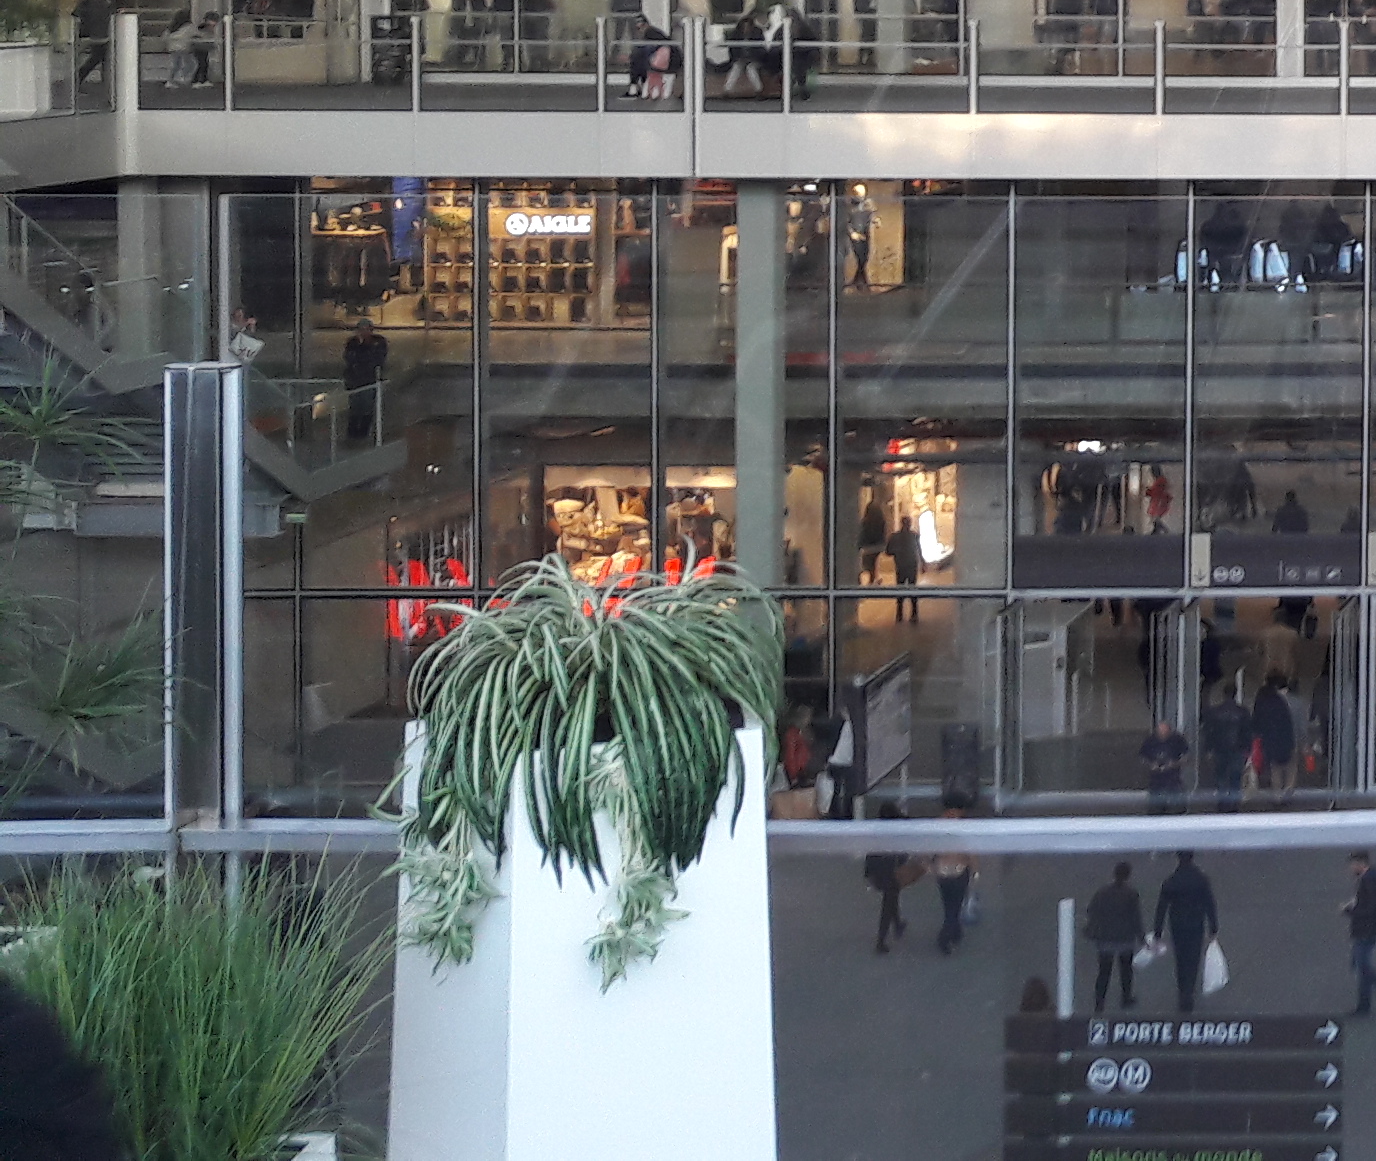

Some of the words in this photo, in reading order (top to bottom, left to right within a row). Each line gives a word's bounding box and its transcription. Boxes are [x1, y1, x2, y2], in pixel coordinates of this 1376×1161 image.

[528, 215, 591, 233] AIGLE
[1113, 1021, 1175, 1045] PORTE
[1178, 1021, 1253, 1045] BERGER
